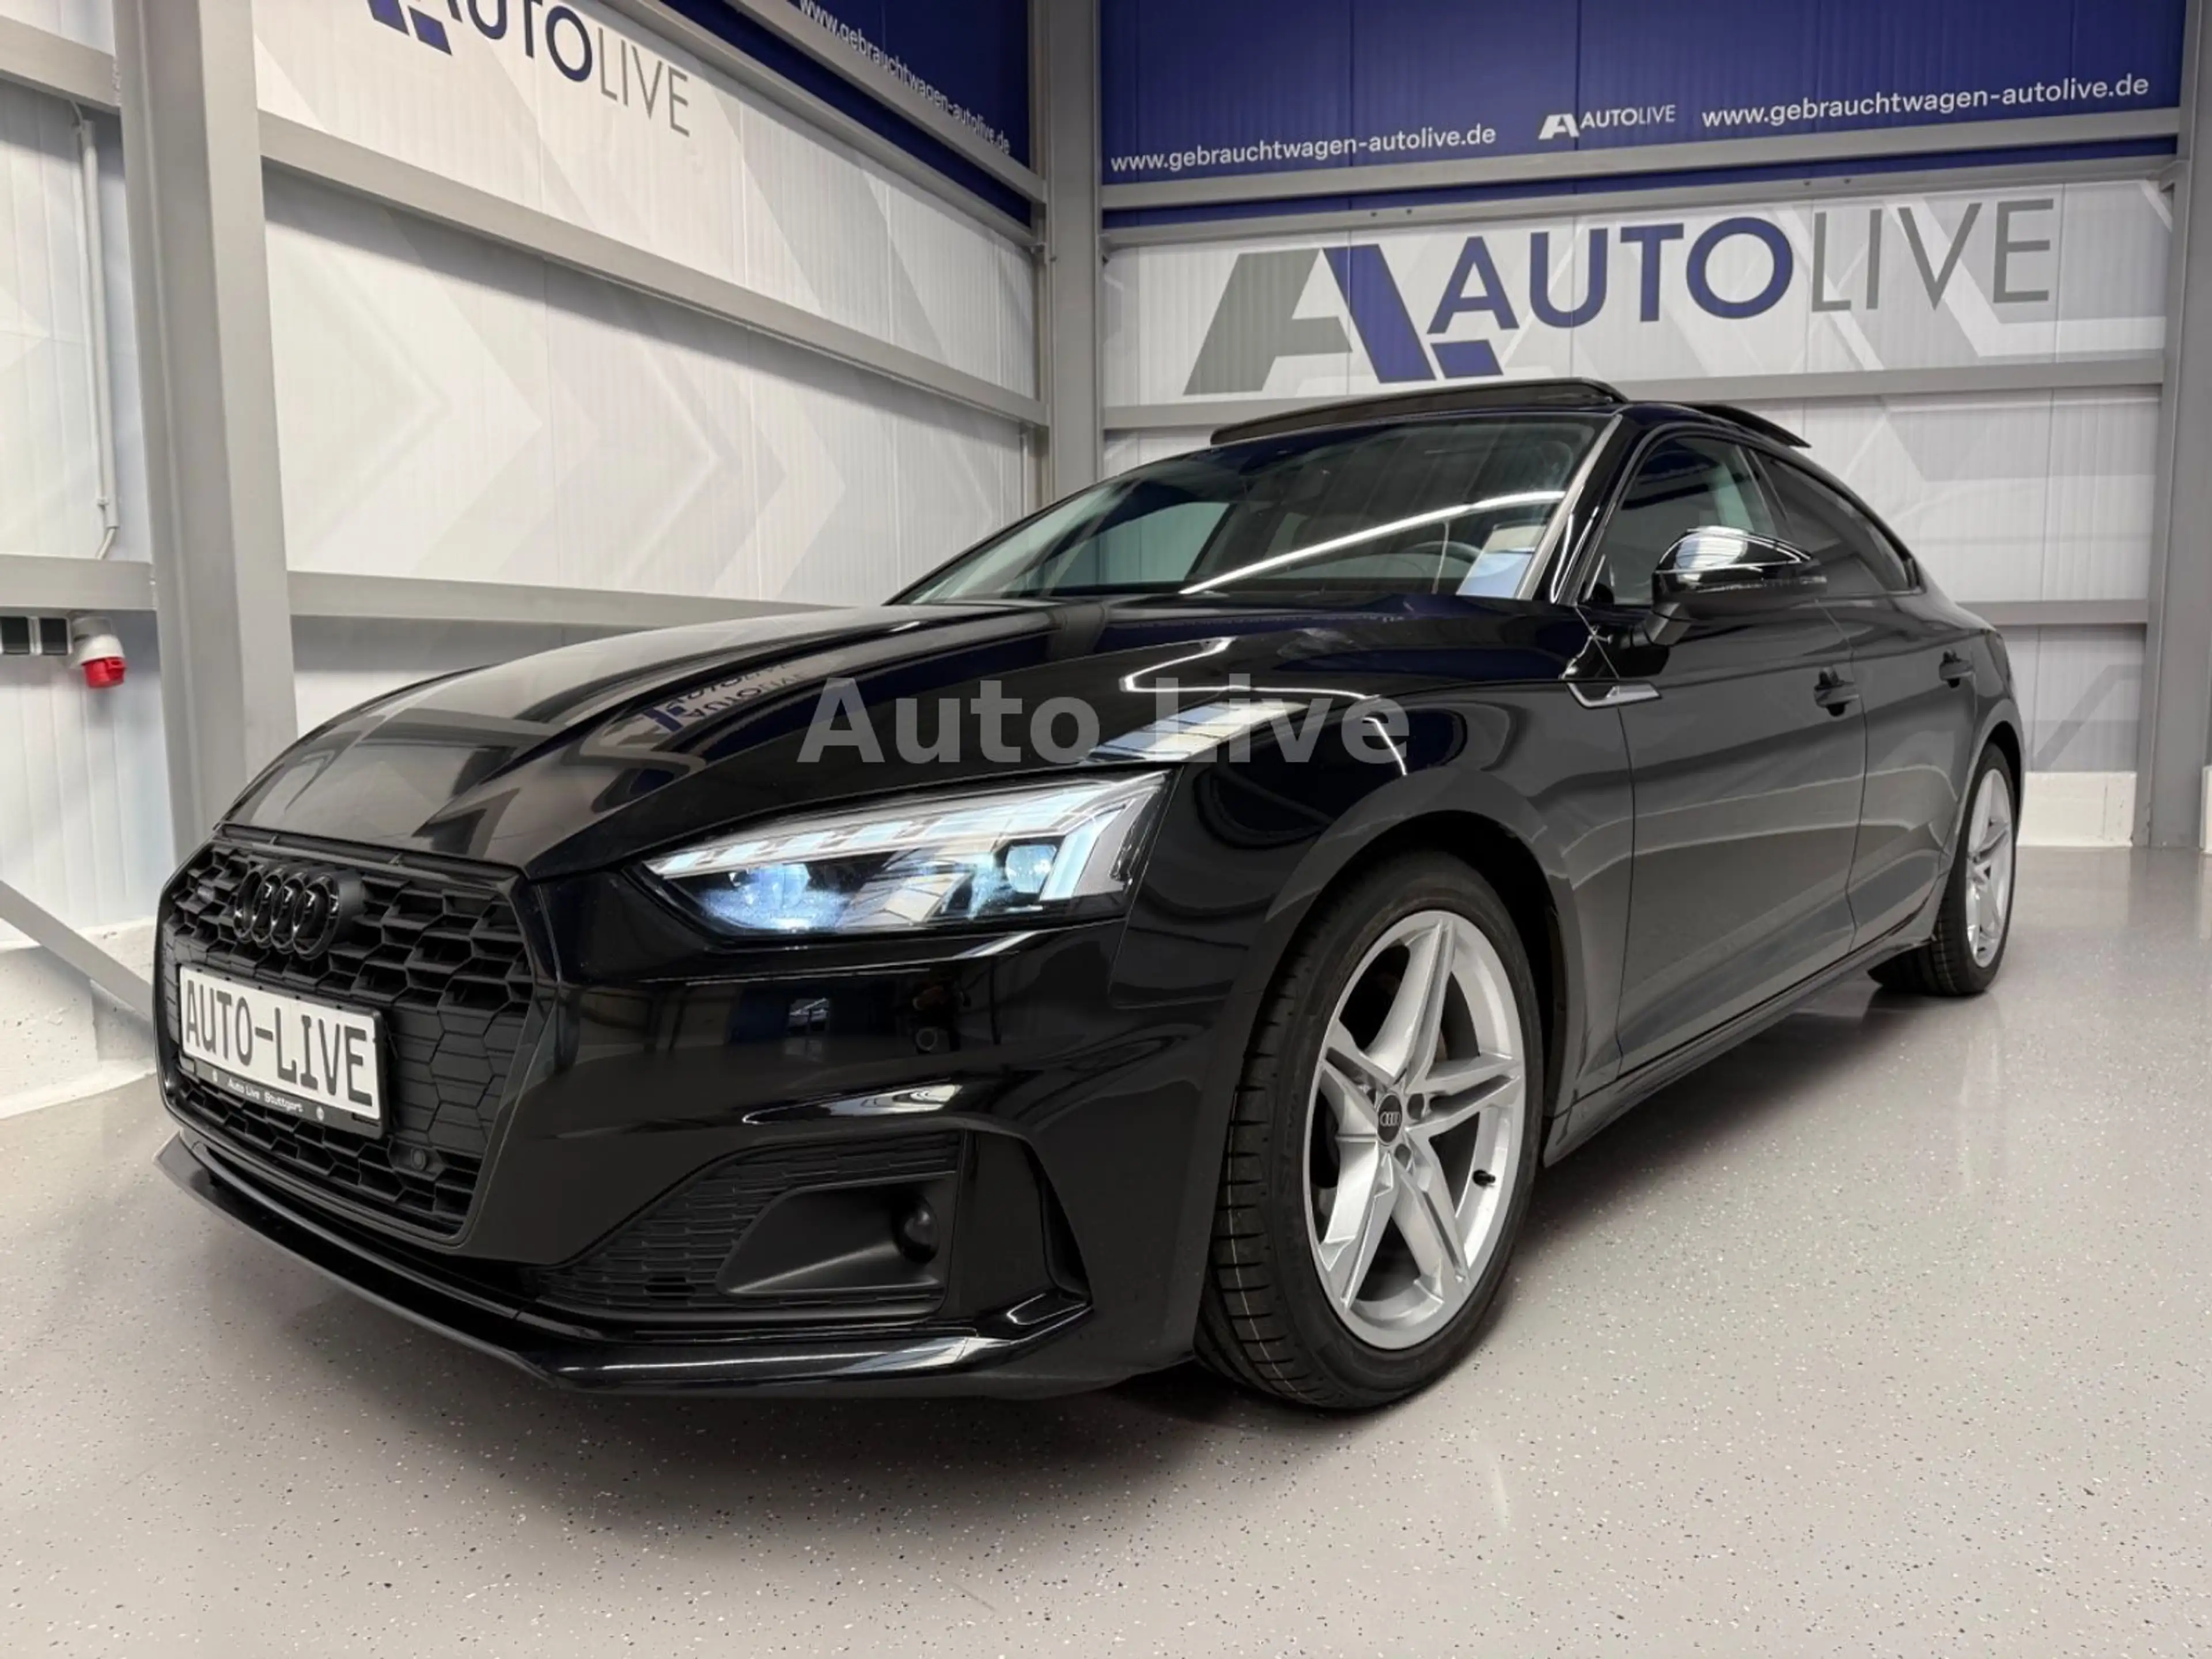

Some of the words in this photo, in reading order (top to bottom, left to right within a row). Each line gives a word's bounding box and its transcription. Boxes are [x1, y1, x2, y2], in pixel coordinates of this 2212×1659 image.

[449, 0, 690, 137] UTOLIVE
[1581, 104, 1676, 129] AUTOLIVE
[1702, 73, 2150, 127] www.gebrauchtwagen-autolive.de
[1111, 123, 1496, 172] www.gebrauchtwagen-autolive.de
[1427, 198, 2054, 334] AUTOLIVE
[185, 980, 373, 1107] AUTO-LIVE
[228, 1077, 244, 1094] Auto
[246, 1085, 260, 1100] Live
